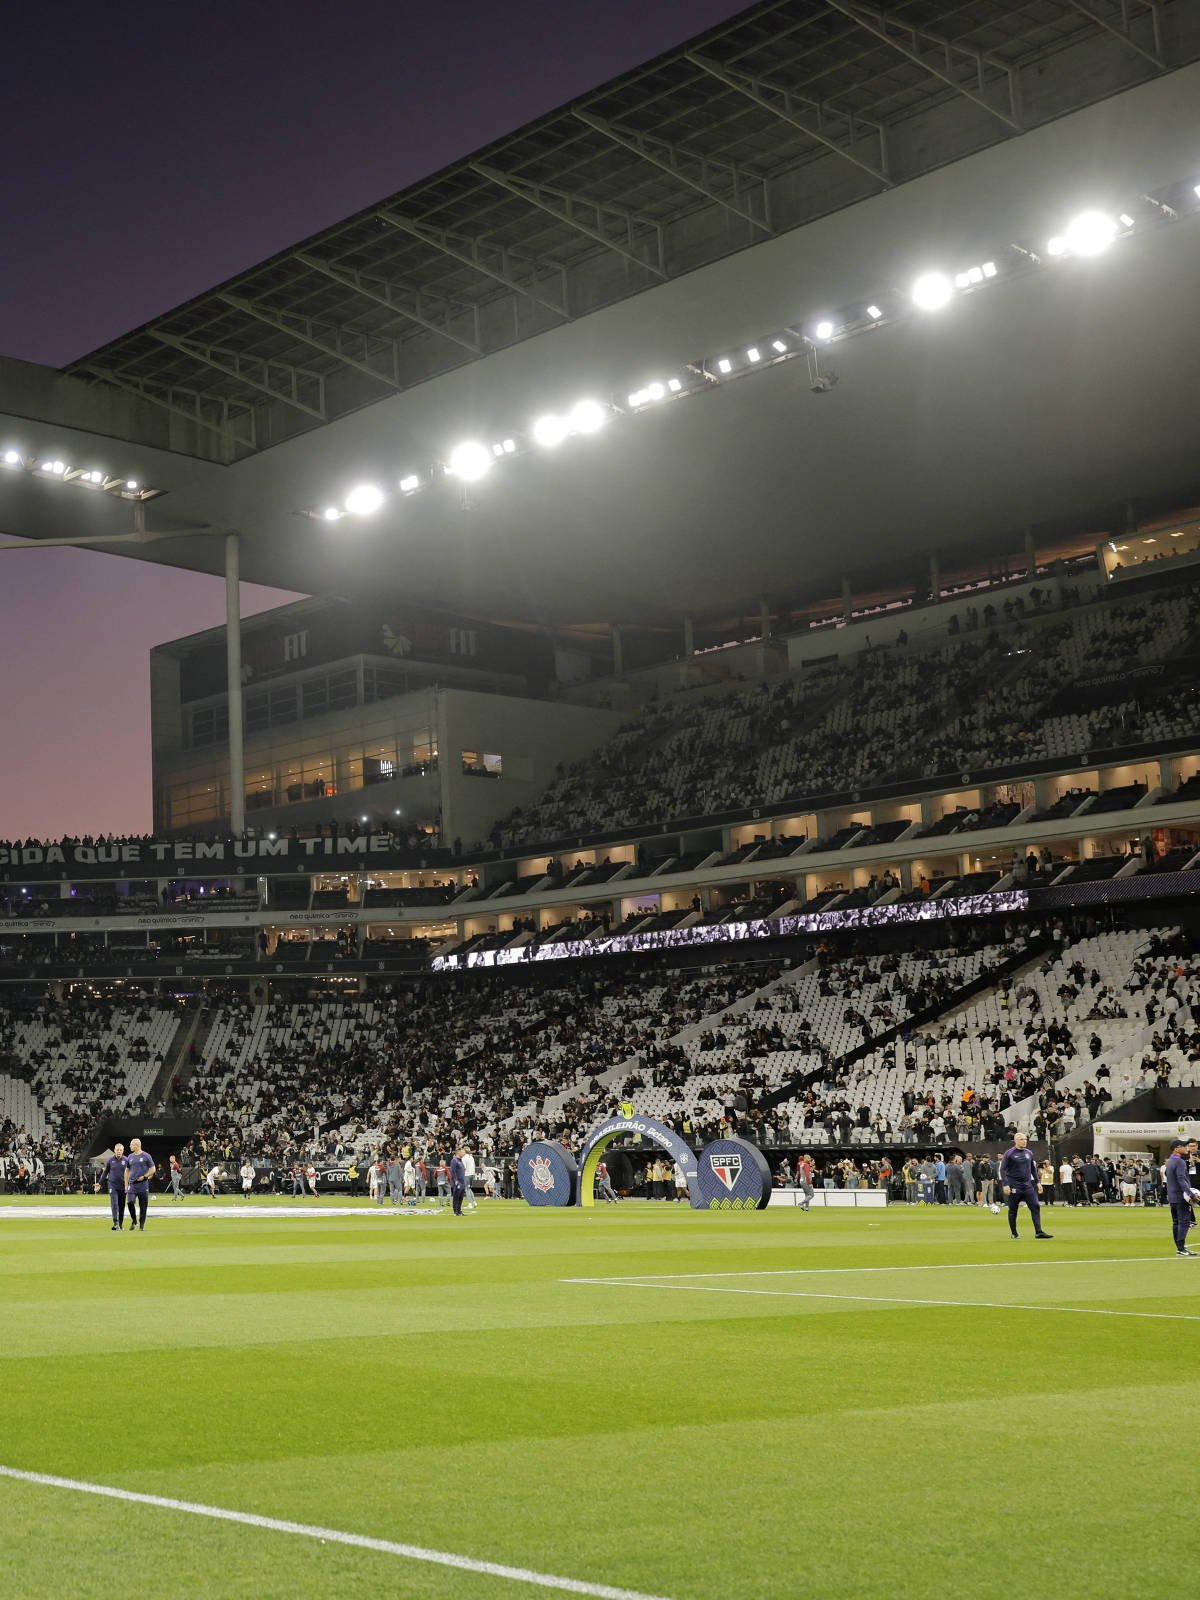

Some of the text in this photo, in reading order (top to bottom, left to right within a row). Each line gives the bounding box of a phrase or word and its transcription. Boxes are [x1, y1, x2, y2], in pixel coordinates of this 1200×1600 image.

[74, 843, 141, 865] QUE
[149, 842, 225, 861] TEM
[234, 837, 289, 858] UM
[299, 834, 391, 856] TIME
[589, 1121, 646, 1149] BRASILEIRÃO
[712, 1156, 740, 1167] SPFC
